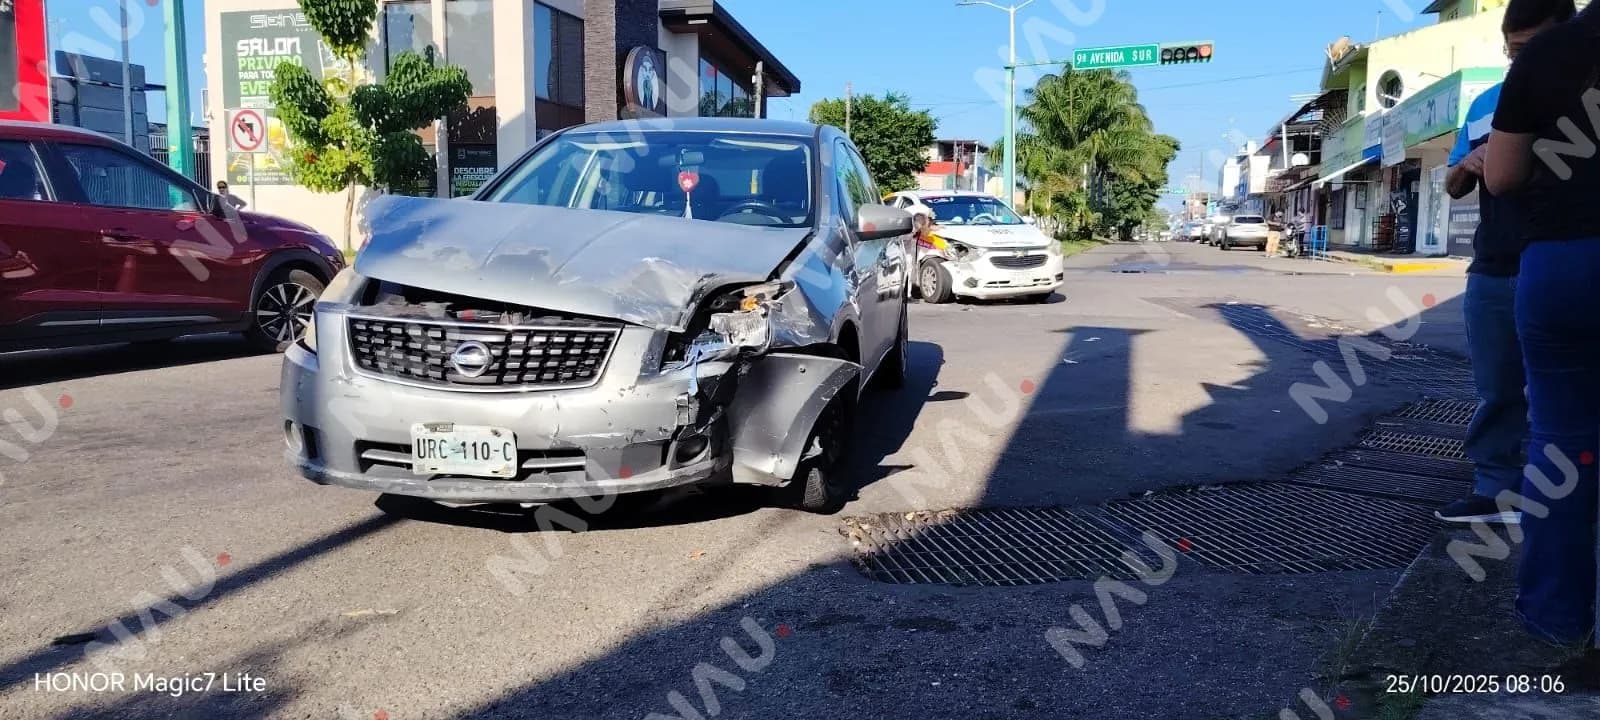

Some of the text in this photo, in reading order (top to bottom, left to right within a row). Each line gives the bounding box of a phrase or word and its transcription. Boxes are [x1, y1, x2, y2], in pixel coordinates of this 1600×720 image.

[1090, 51, 1124, 64] AVENIDA
[1132, 49, 1152, 61] SUR
[416, 438, 512, 462] URC-110-C
